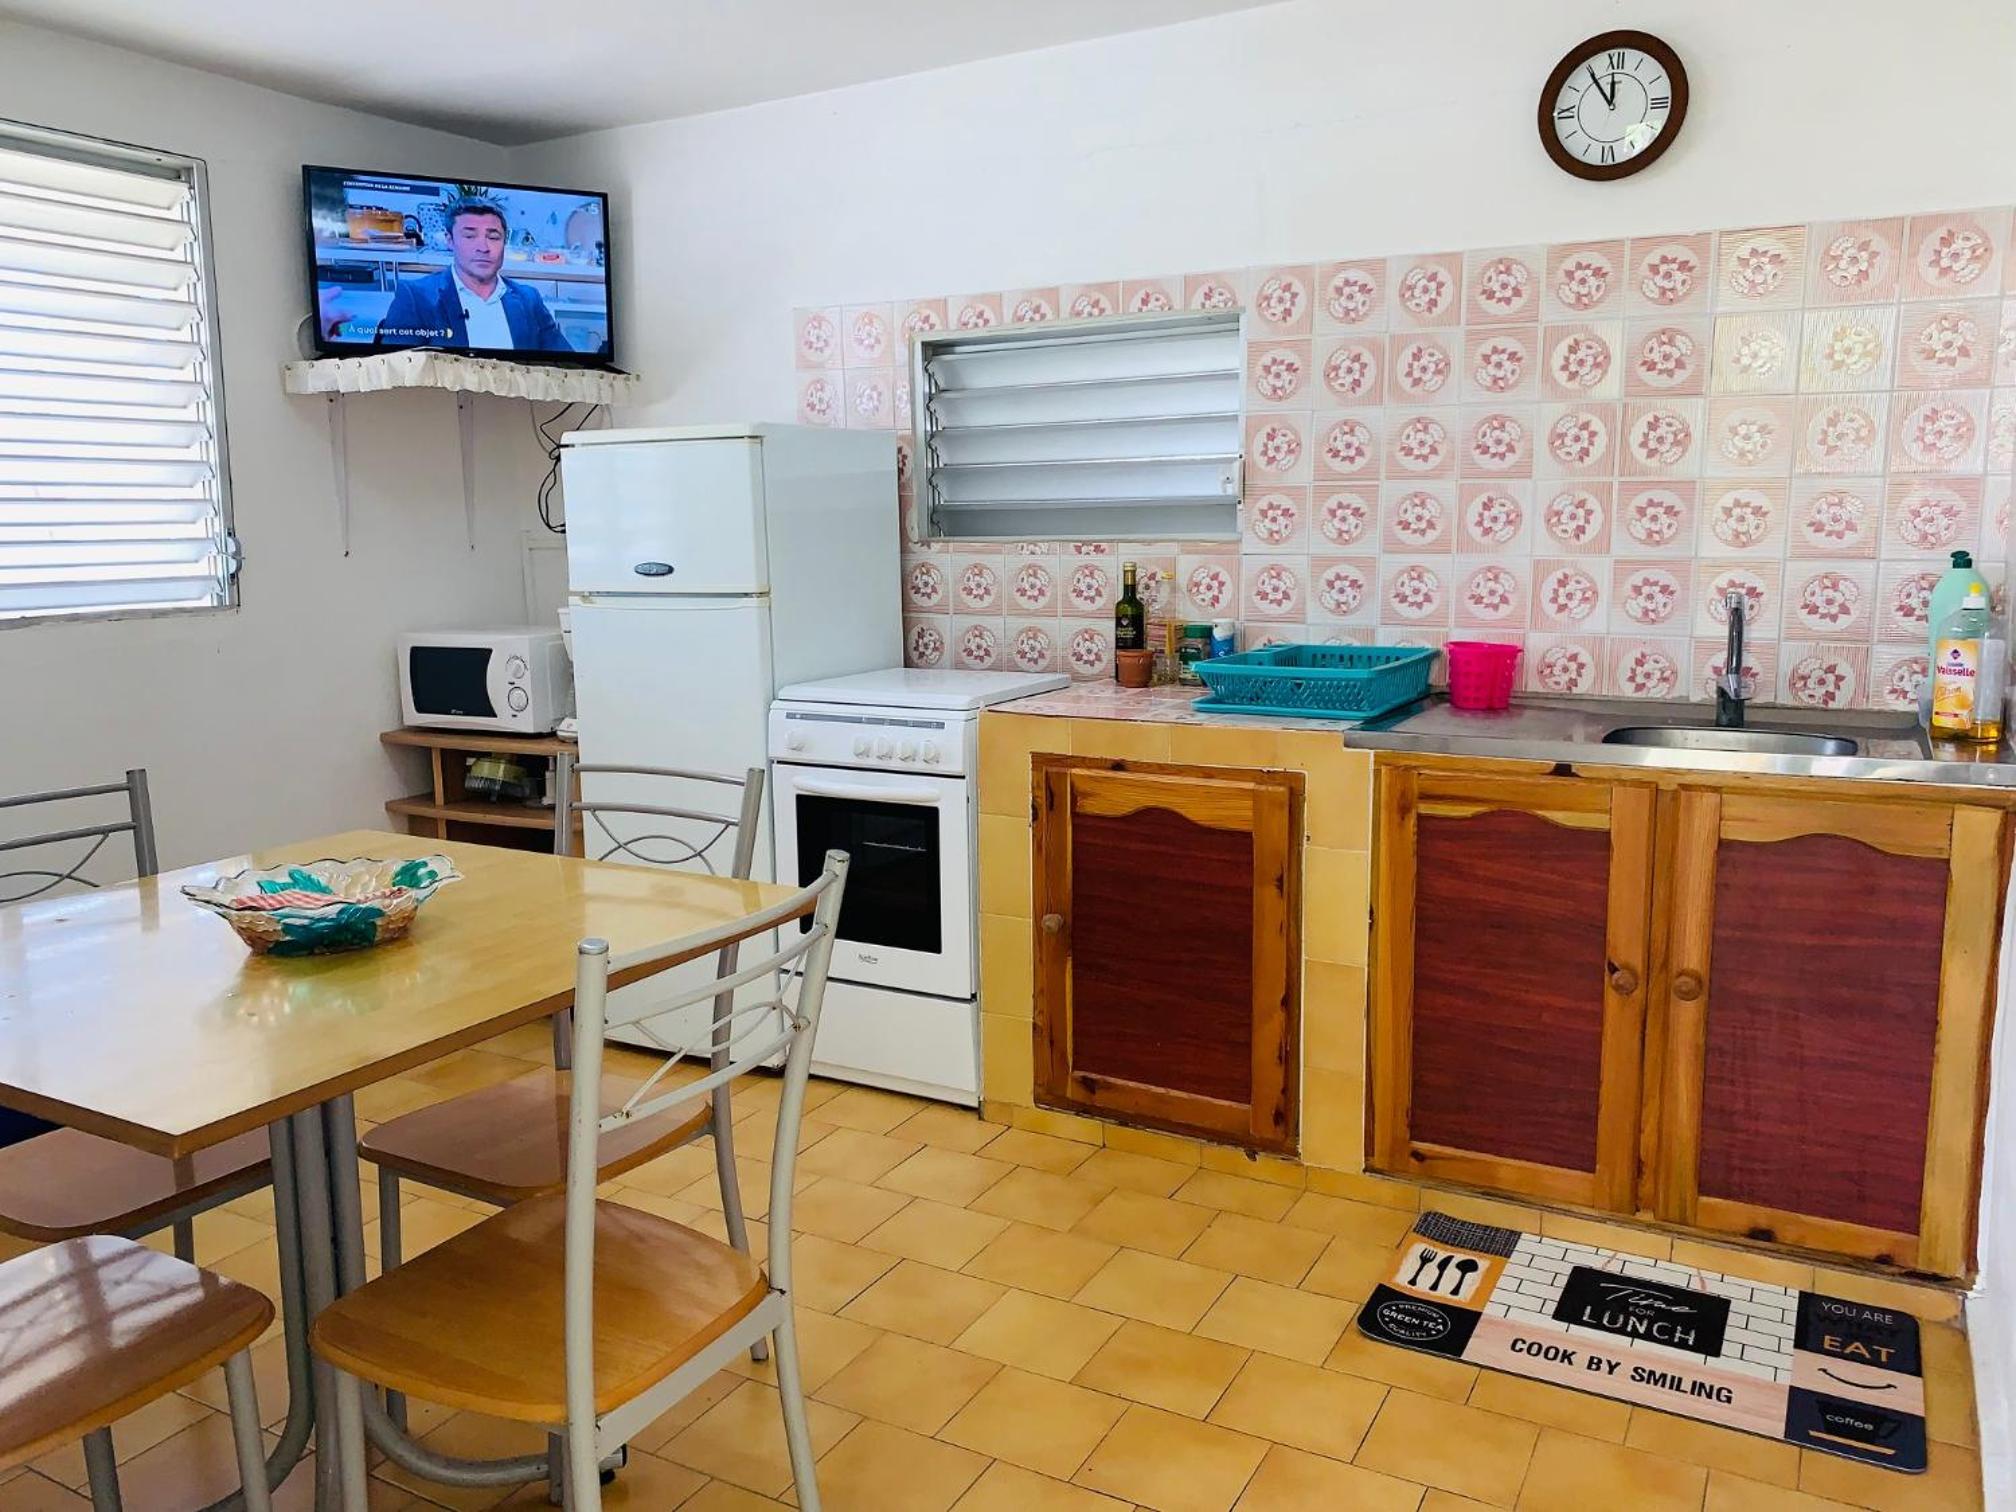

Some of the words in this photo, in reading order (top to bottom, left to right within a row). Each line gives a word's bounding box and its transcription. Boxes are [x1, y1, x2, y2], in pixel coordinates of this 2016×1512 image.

[1606, 51, 1626, 71] XII
[1557, 105, 1576, 120] IX
[1650, 96, 1670, 110] III
[1601, 145, 1615, 163] VI
[357, 325, 378, 335] quoi
[379, 328, 397, 336] sert
[399, 328, 413, 336] cet
[415, 328, 438, 338] objet
[1600, 1283, 1698, 1313] Time
[1382, 1308, 1420, 1324] GREEN
[1422, 1320, 1444, 1331] TEA
[1398, 1304, 1440, 1318] PREMIUM
[1628, 1306, 1656, 1317] FOR
[1822, 1302, 1857, 1317] YOU
[1861, 1311, 1893, 1325] ARE
[1582, 1305, 1696, 1346] LUNCH
[1823, 1334, 1896, 1362] EAT
[1510, 1337, 1578, 1366] COOK
[1586, 1355, 1621, 1375] BY
[1630, 1366, 1734, 1404] SMILING
[1826, 1414, 1874, 1431] coffee
